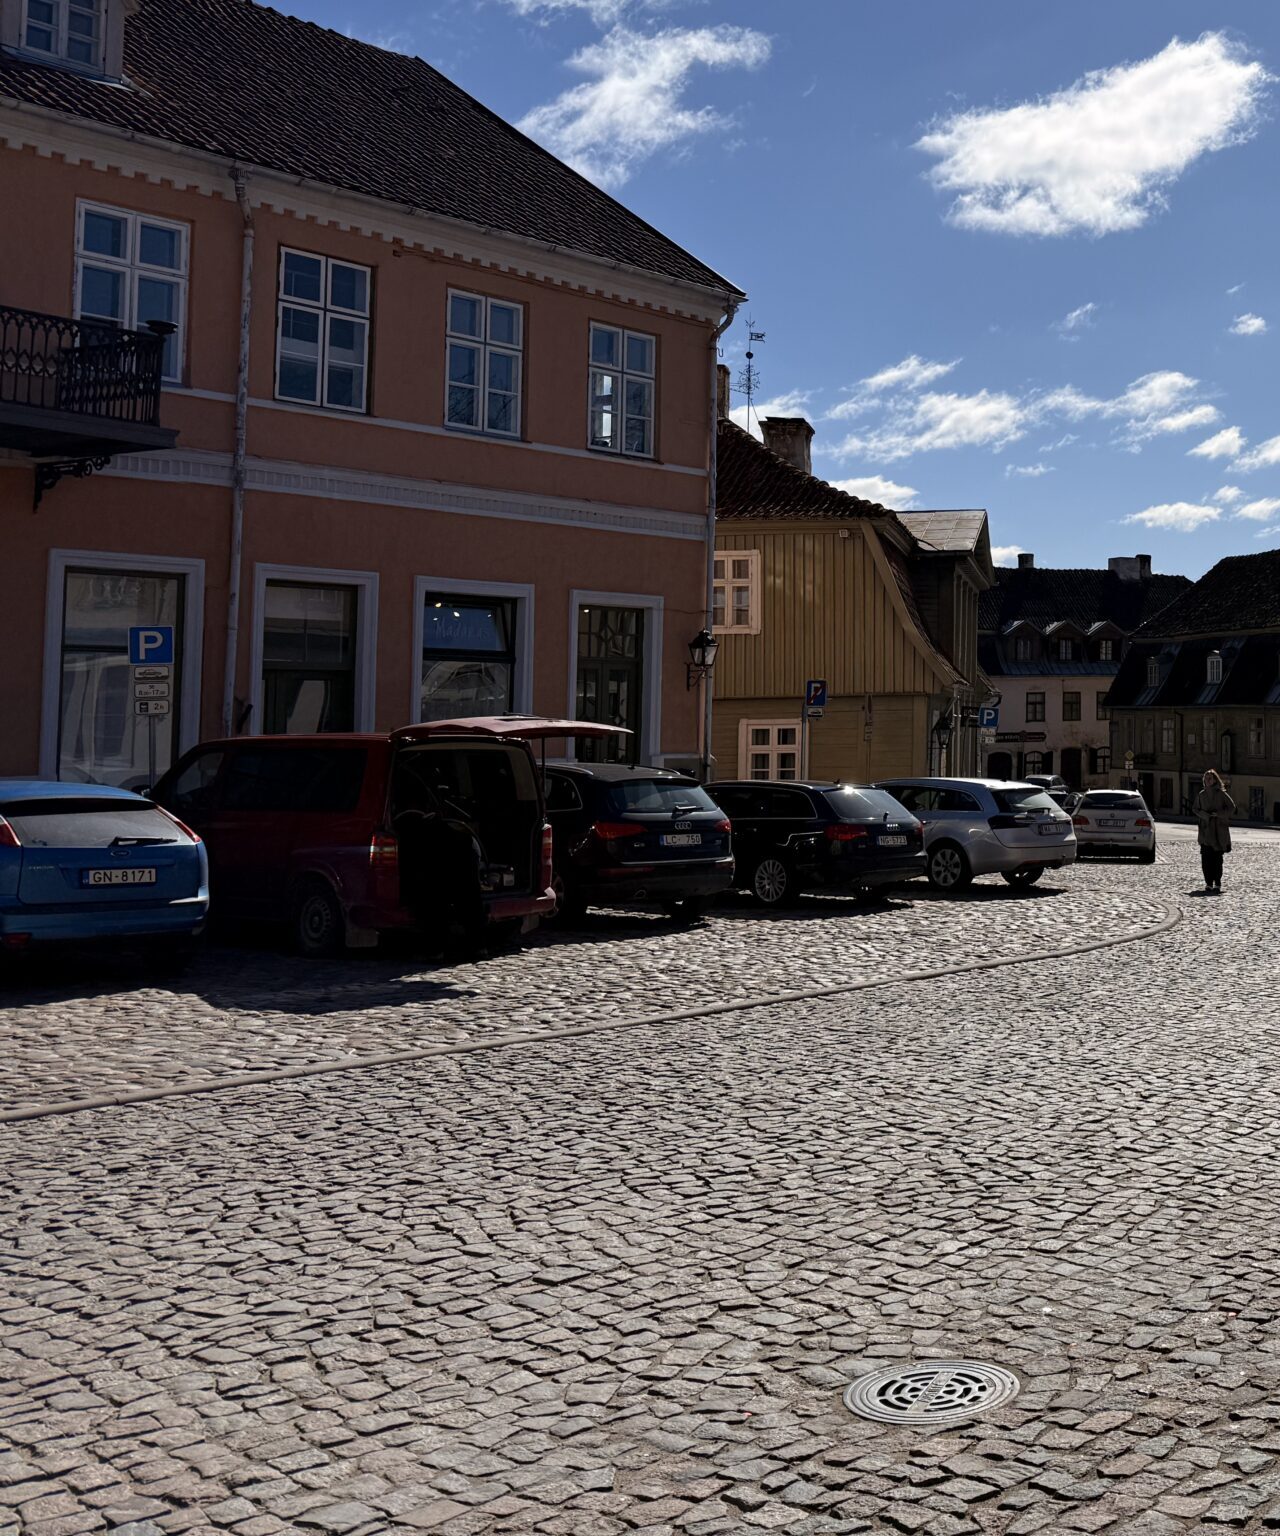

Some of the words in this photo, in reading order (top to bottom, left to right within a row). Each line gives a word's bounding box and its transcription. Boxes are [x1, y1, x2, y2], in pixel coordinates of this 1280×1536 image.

[139, 630, 164, 661] P
[984, 709, 996, 725] P
[93, 870, 153, 883] GN-8171
